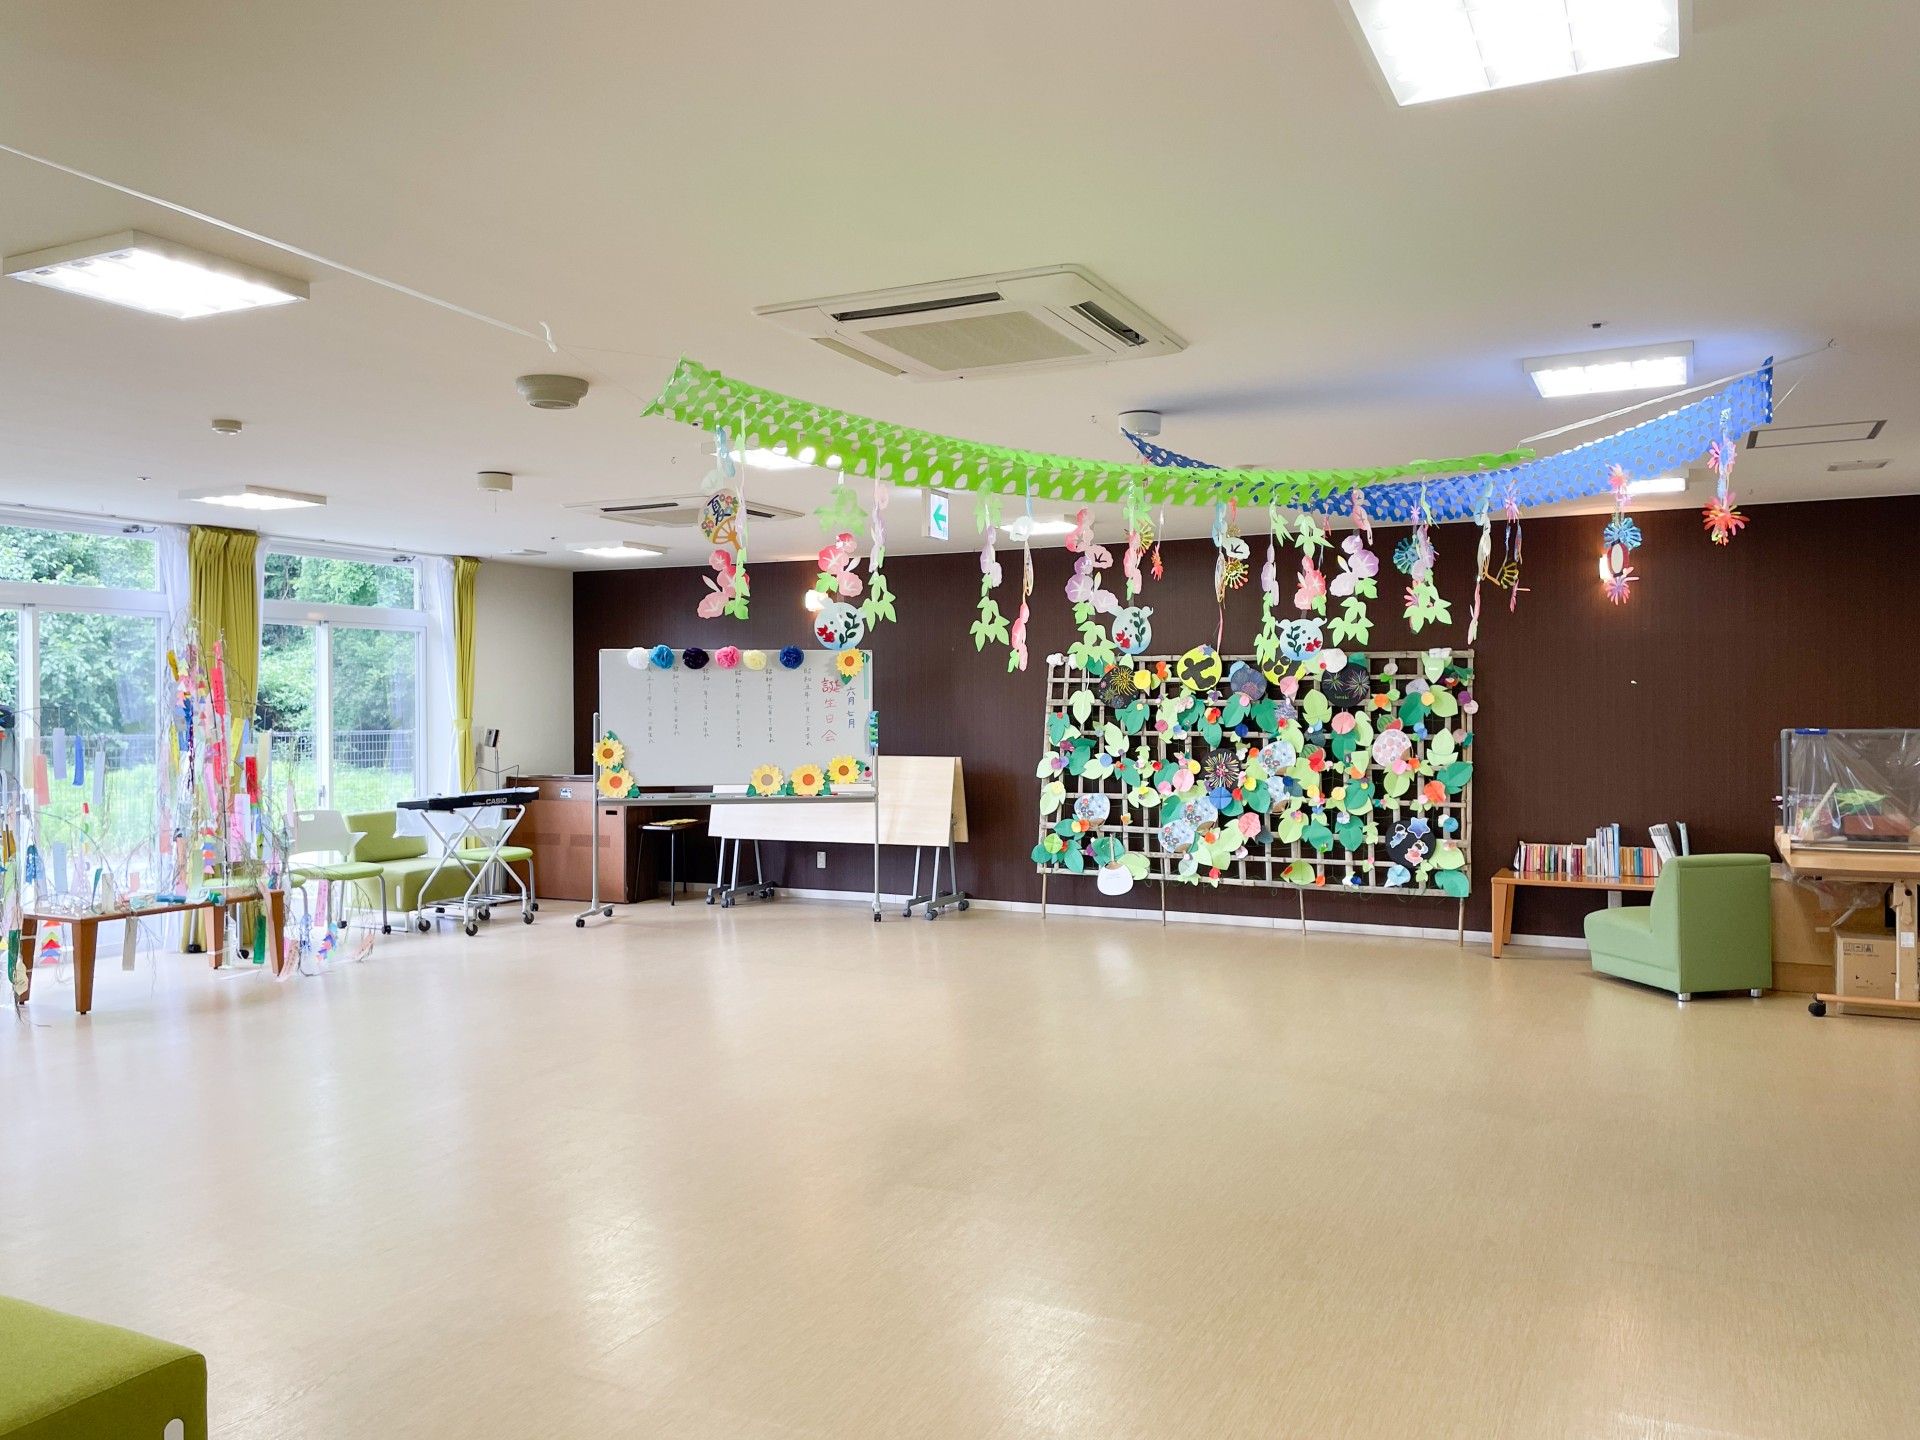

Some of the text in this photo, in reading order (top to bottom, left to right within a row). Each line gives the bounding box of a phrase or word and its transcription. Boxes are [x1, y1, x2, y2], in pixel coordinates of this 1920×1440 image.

[707, 494, 731, 526] 夏
[821, 677, 841, 742] 誕生日会
[486, 797, 507, 805] CASIO
